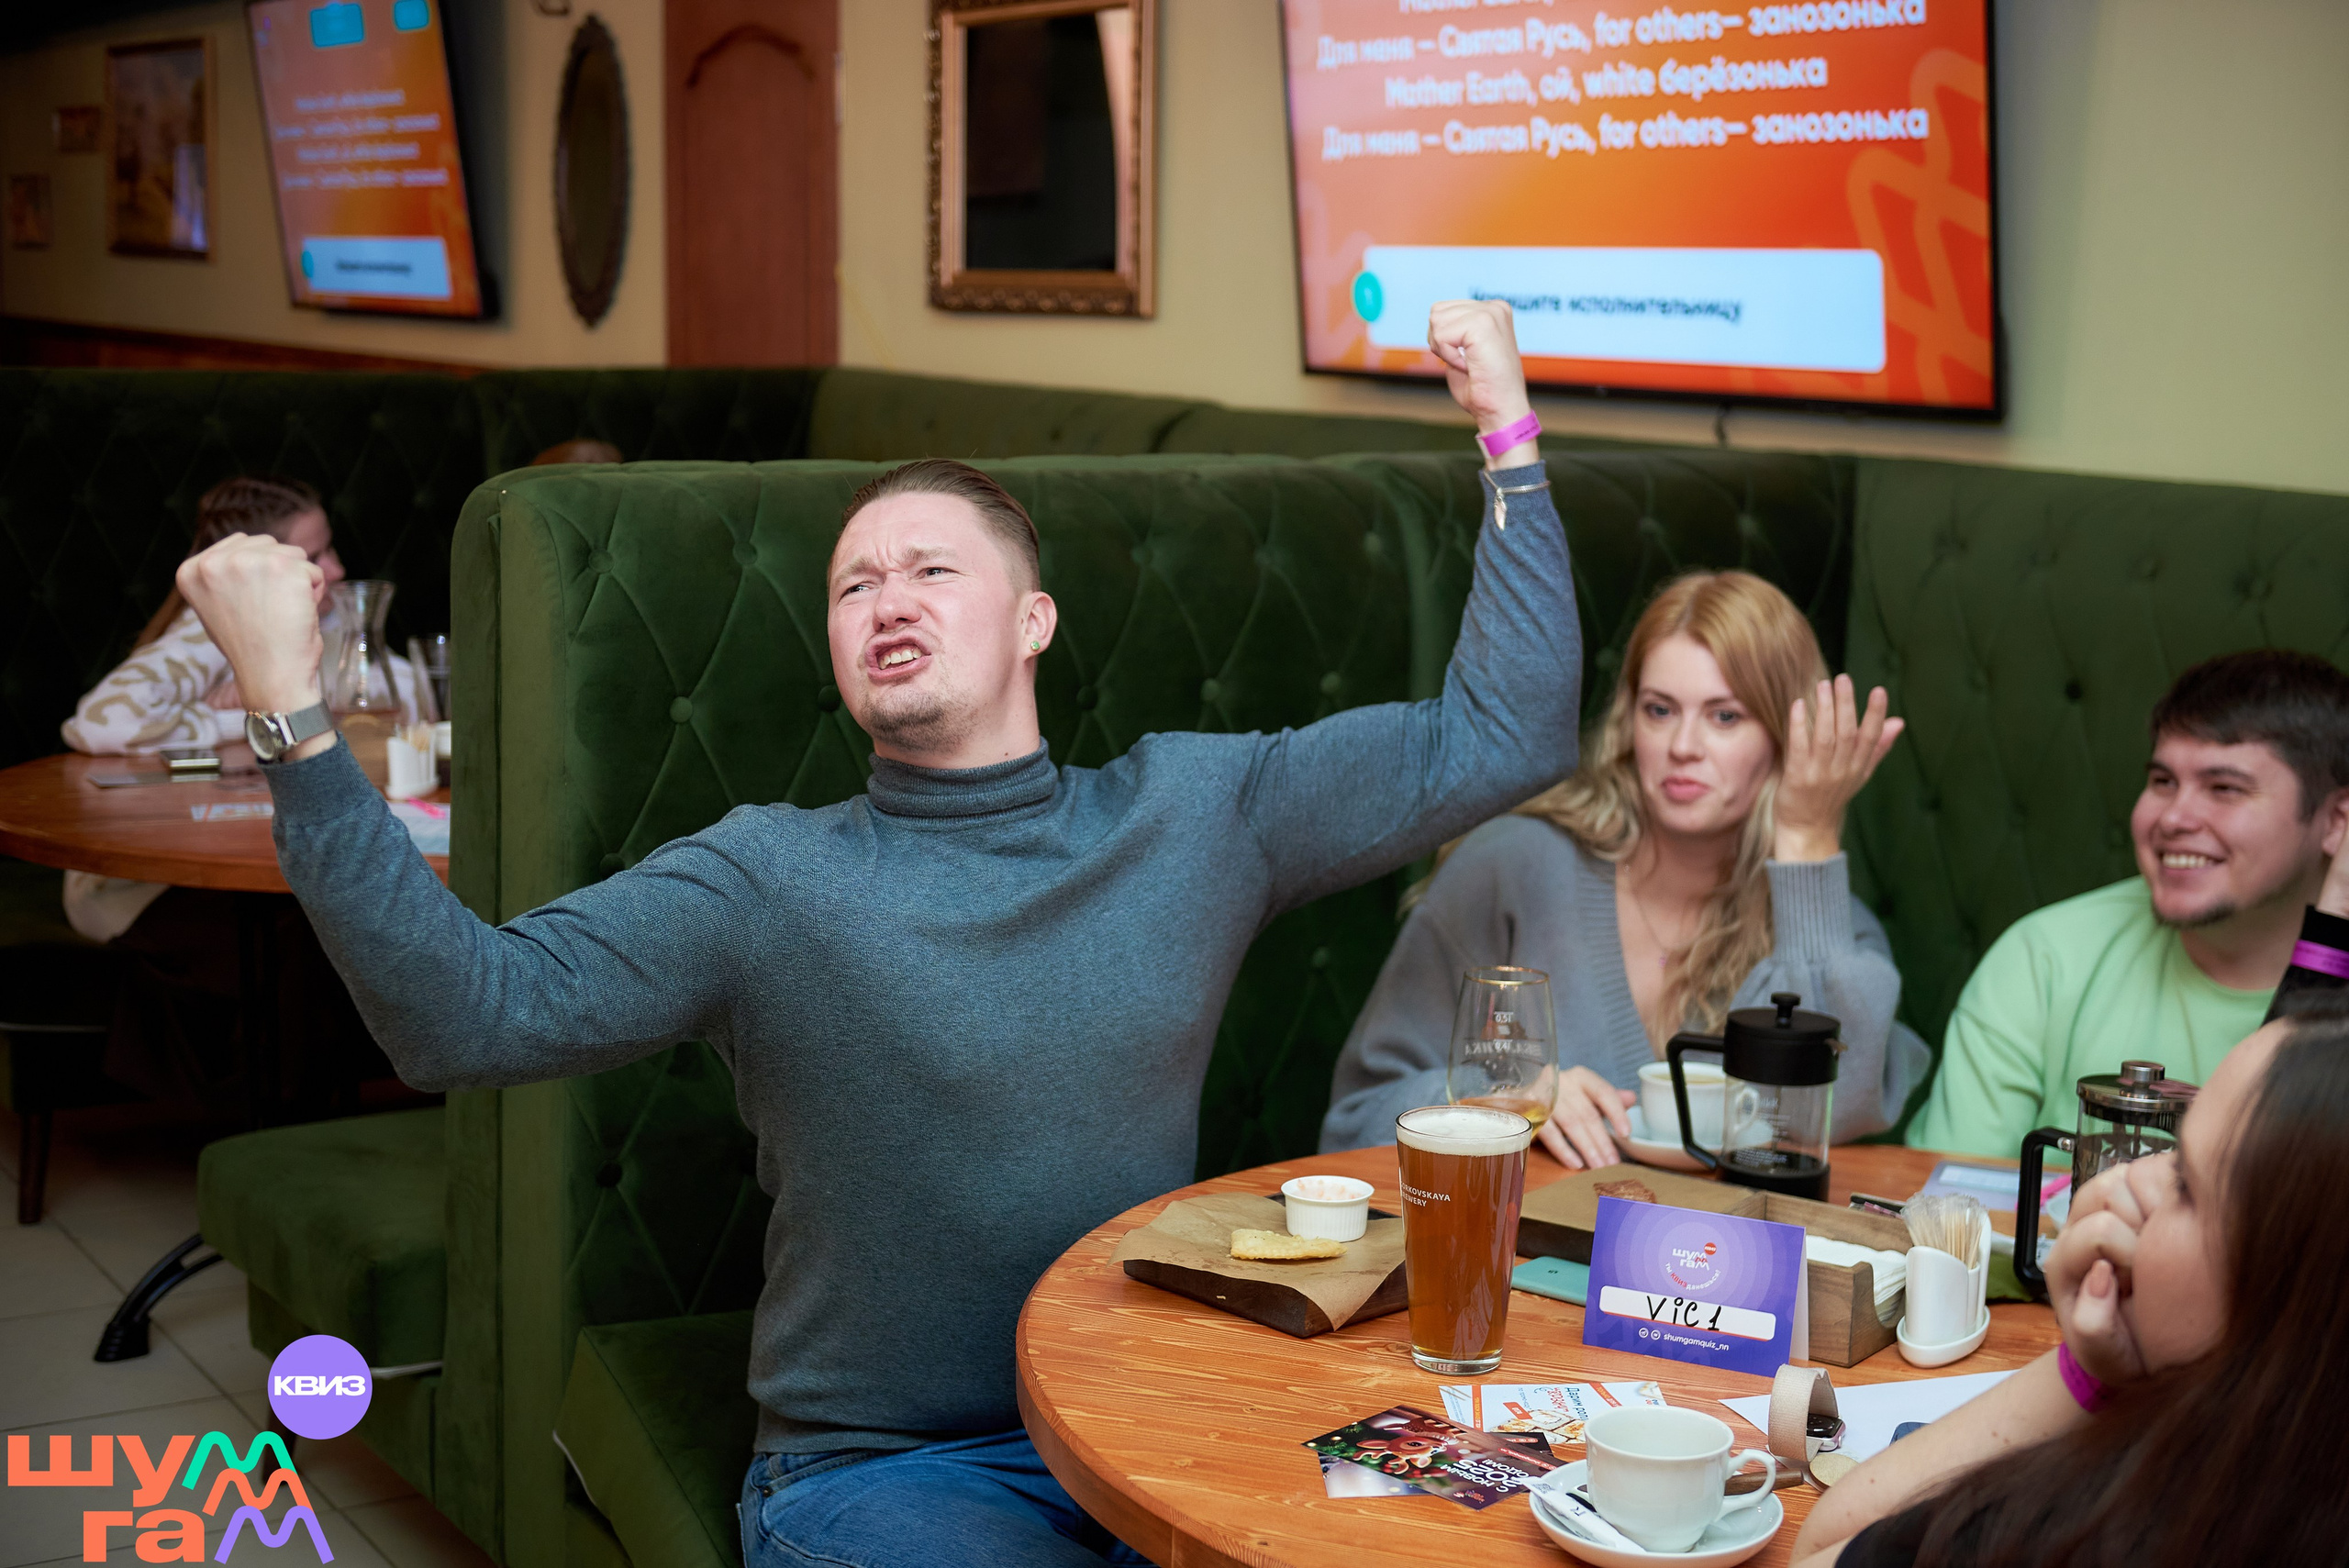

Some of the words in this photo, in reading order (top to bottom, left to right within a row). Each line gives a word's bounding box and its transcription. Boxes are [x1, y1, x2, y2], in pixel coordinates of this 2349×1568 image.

[1594, 11, 1633, 47] for
[1748, 0, 1926, 37] занозонька
[1385, 75, 1464, 109] Mother
[1466, 68, 1538, 107] Earth,
[1582, 60, 1655, 99] white
[1658, 54, 1828, 103] берёзонька
[1598, 113, 1638, 150] for
[1752, 107, 1929, 145] занозонька
[1663, 1333, 1730, 1351] shumgamquiz_nn
[1440, 1463, 1496, 1488] НОВЫМ
[1453, 1459, 1524, 1488] 2025
[1481, 1458, 1531, 1479] ОДОМ!
